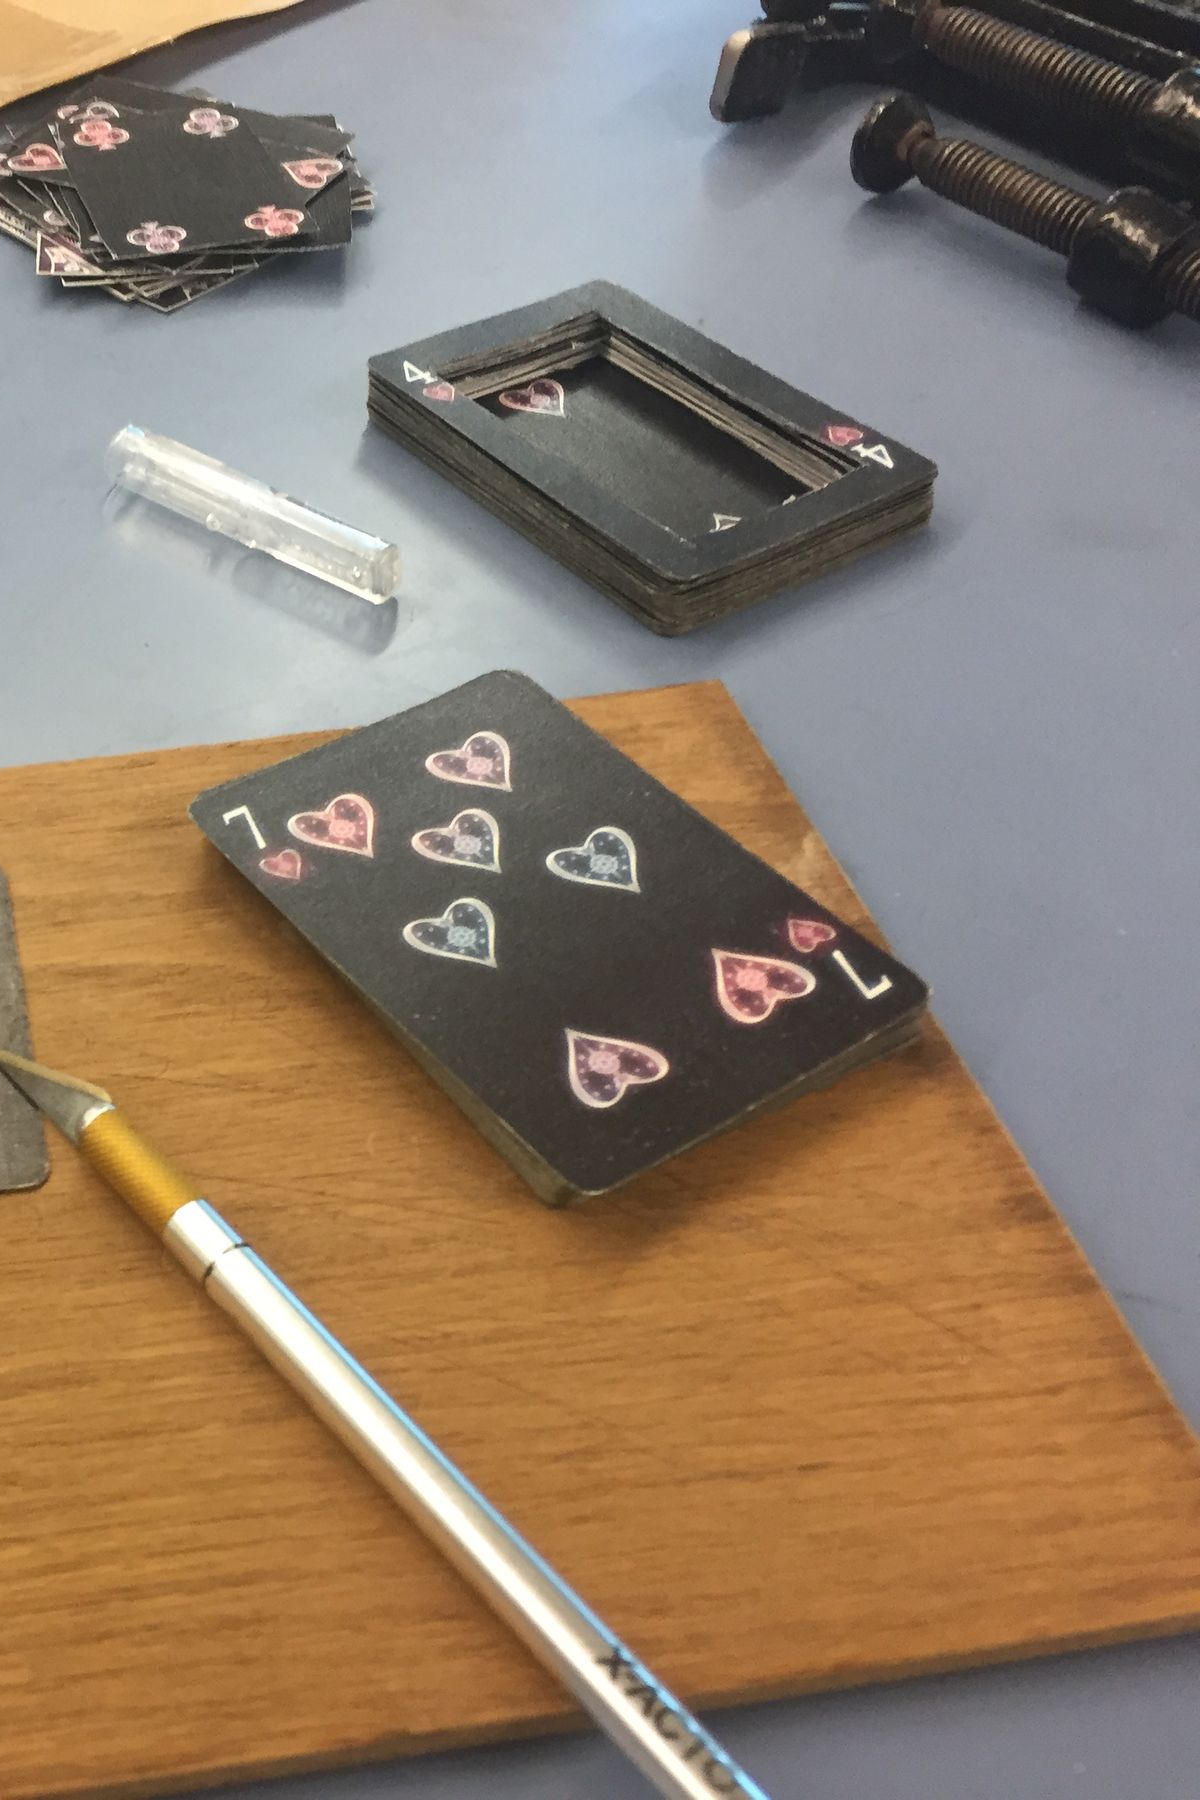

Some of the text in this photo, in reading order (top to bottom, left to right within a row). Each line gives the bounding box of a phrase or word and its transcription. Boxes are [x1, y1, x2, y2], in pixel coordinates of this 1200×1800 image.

[403, 360, 438, 385] 4
[850, 443, 894, 469] 4
[222, 804, 268, 850] 7
[832, 950, 894, 1001] 7
